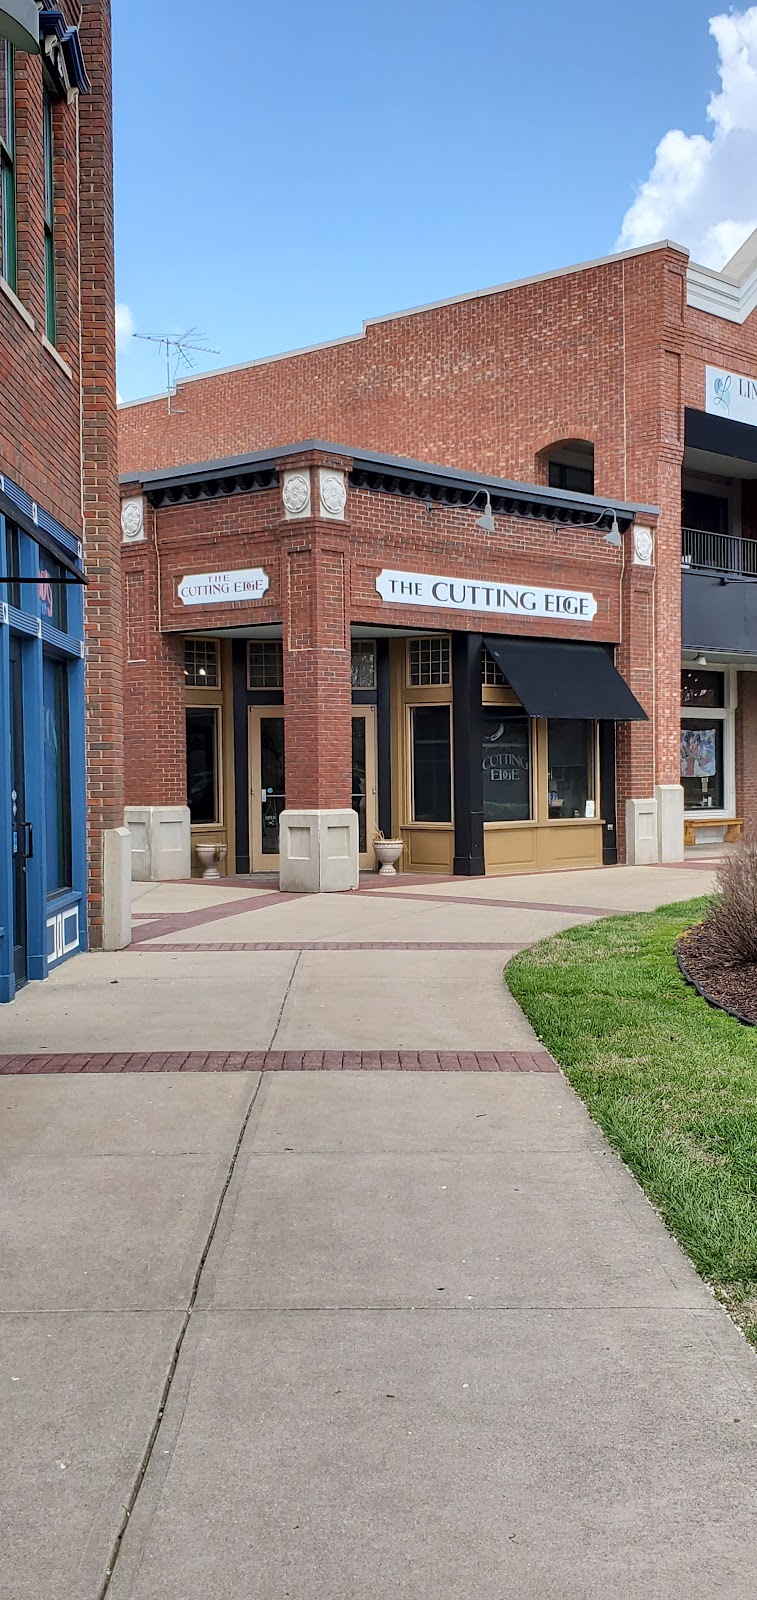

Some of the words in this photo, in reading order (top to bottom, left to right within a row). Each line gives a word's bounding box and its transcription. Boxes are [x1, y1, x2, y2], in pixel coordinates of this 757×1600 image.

[208, 574, 230, 583] THE
[181, 583, 230, 597] CUTTING
[234, 579, 264, 593] EDGE
[388, 579, 423, 597] THE
[431, 582, 537, 611] CUTTING
[544, 594, 589, 616] EDGE
[482, 753, 528, 770] CUTTING
[491, 768, 520, 780] EDGE
